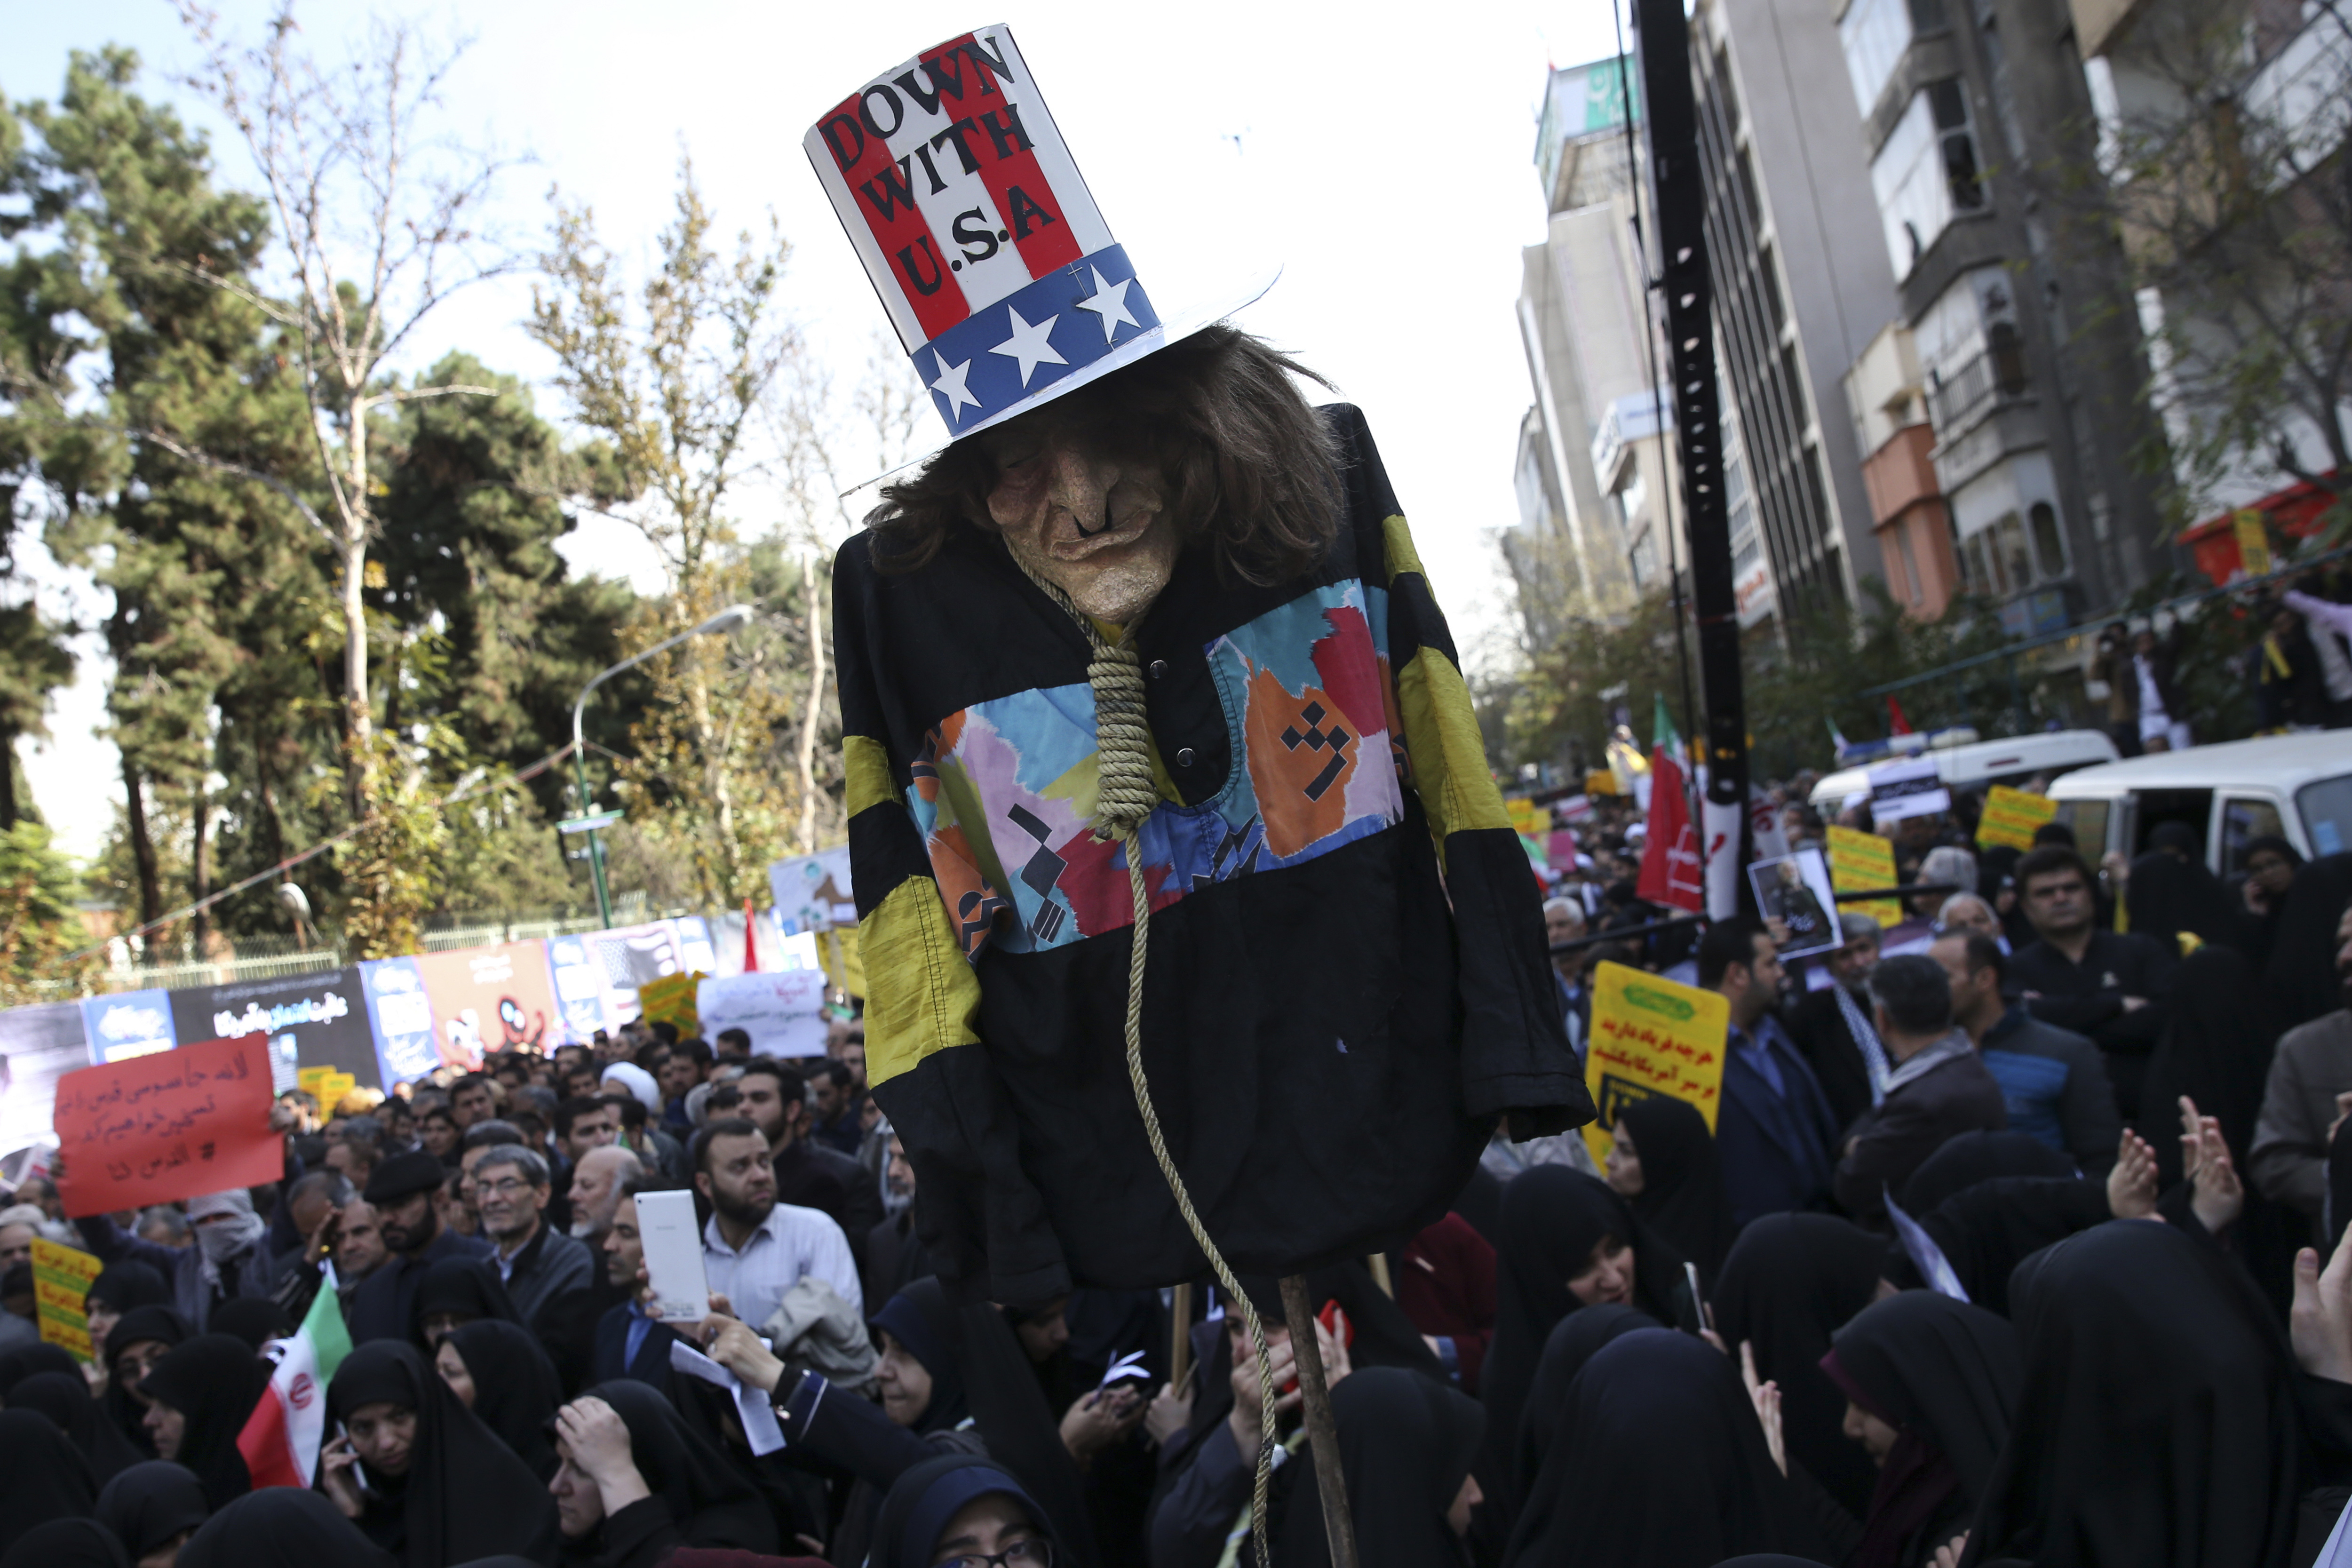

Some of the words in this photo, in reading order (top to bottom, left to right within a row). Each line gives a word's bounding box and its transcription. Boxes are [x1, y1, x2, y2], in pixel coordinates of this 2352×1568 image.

[818, 36, 1015, 173] DOWN
[859, 103, 1035, 223] WITH
[896, 185, 1056, 296] U.S.A
